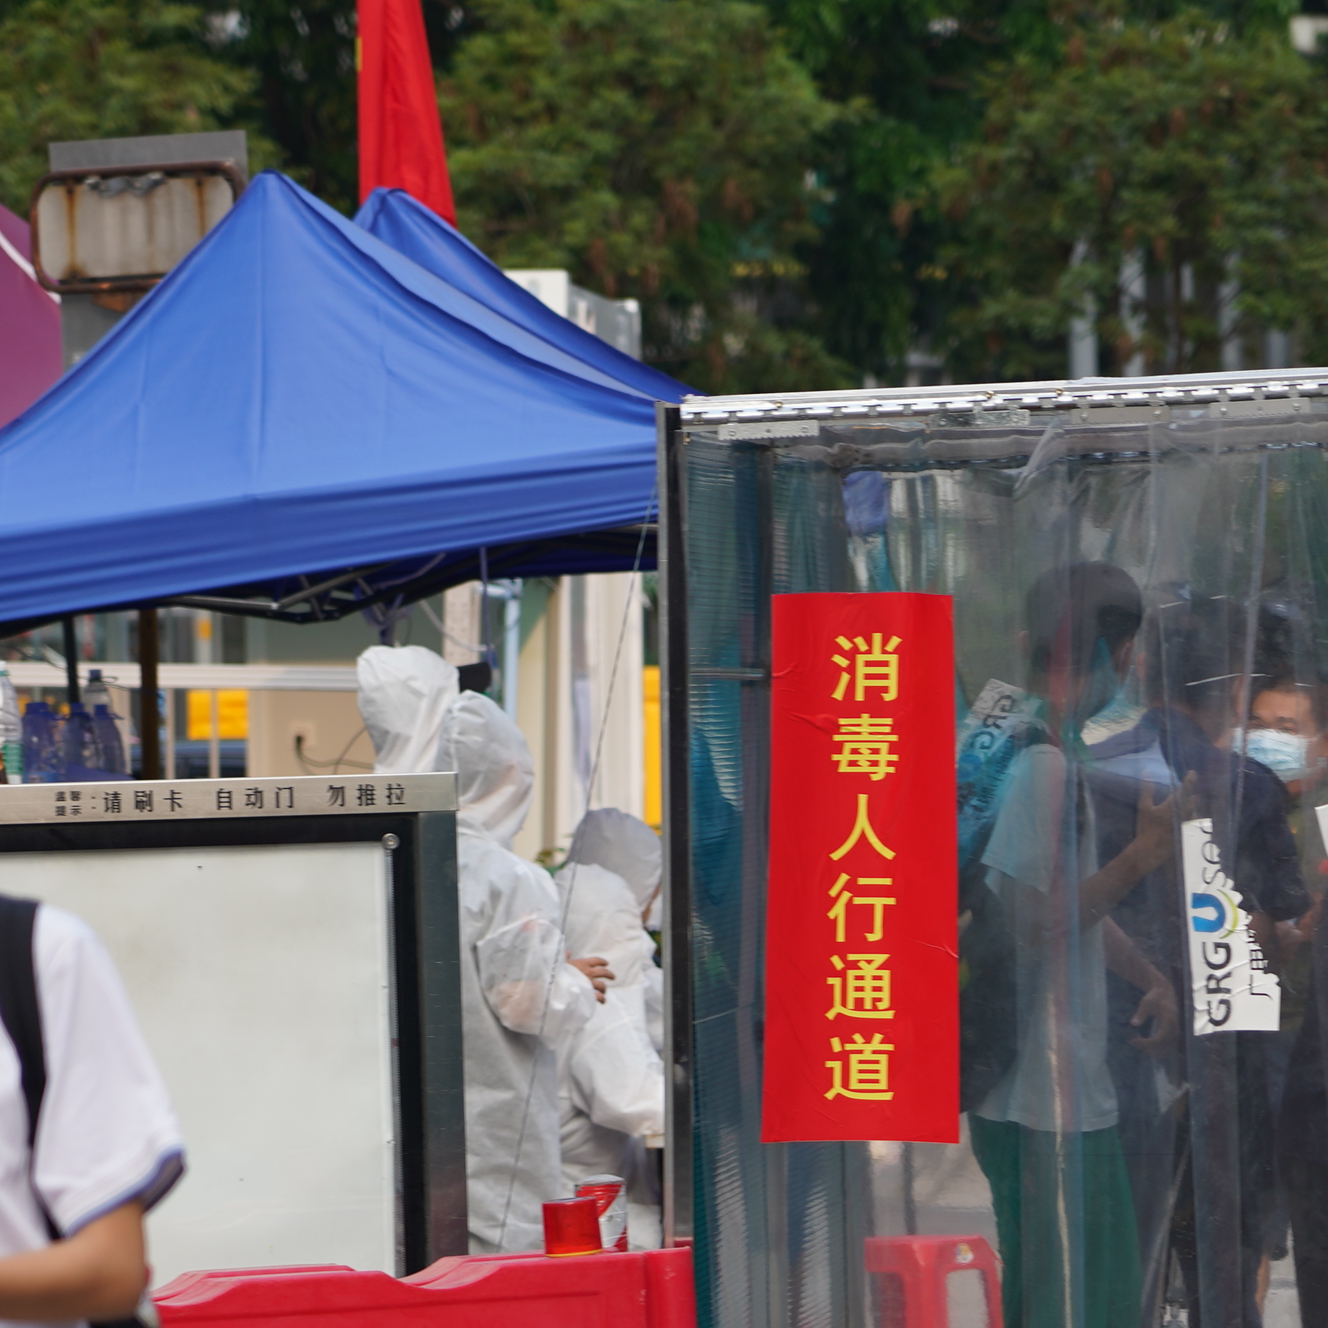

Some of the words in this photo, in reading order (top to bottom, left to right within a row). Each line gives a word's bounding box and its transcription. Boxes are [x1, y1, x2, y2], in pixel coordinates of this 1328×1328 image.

[215, 786, 296, 811] 自动门
[326, 782, 407, 808] 勿推拉
[823, 632, 903, 1101] 消毒人行通道
